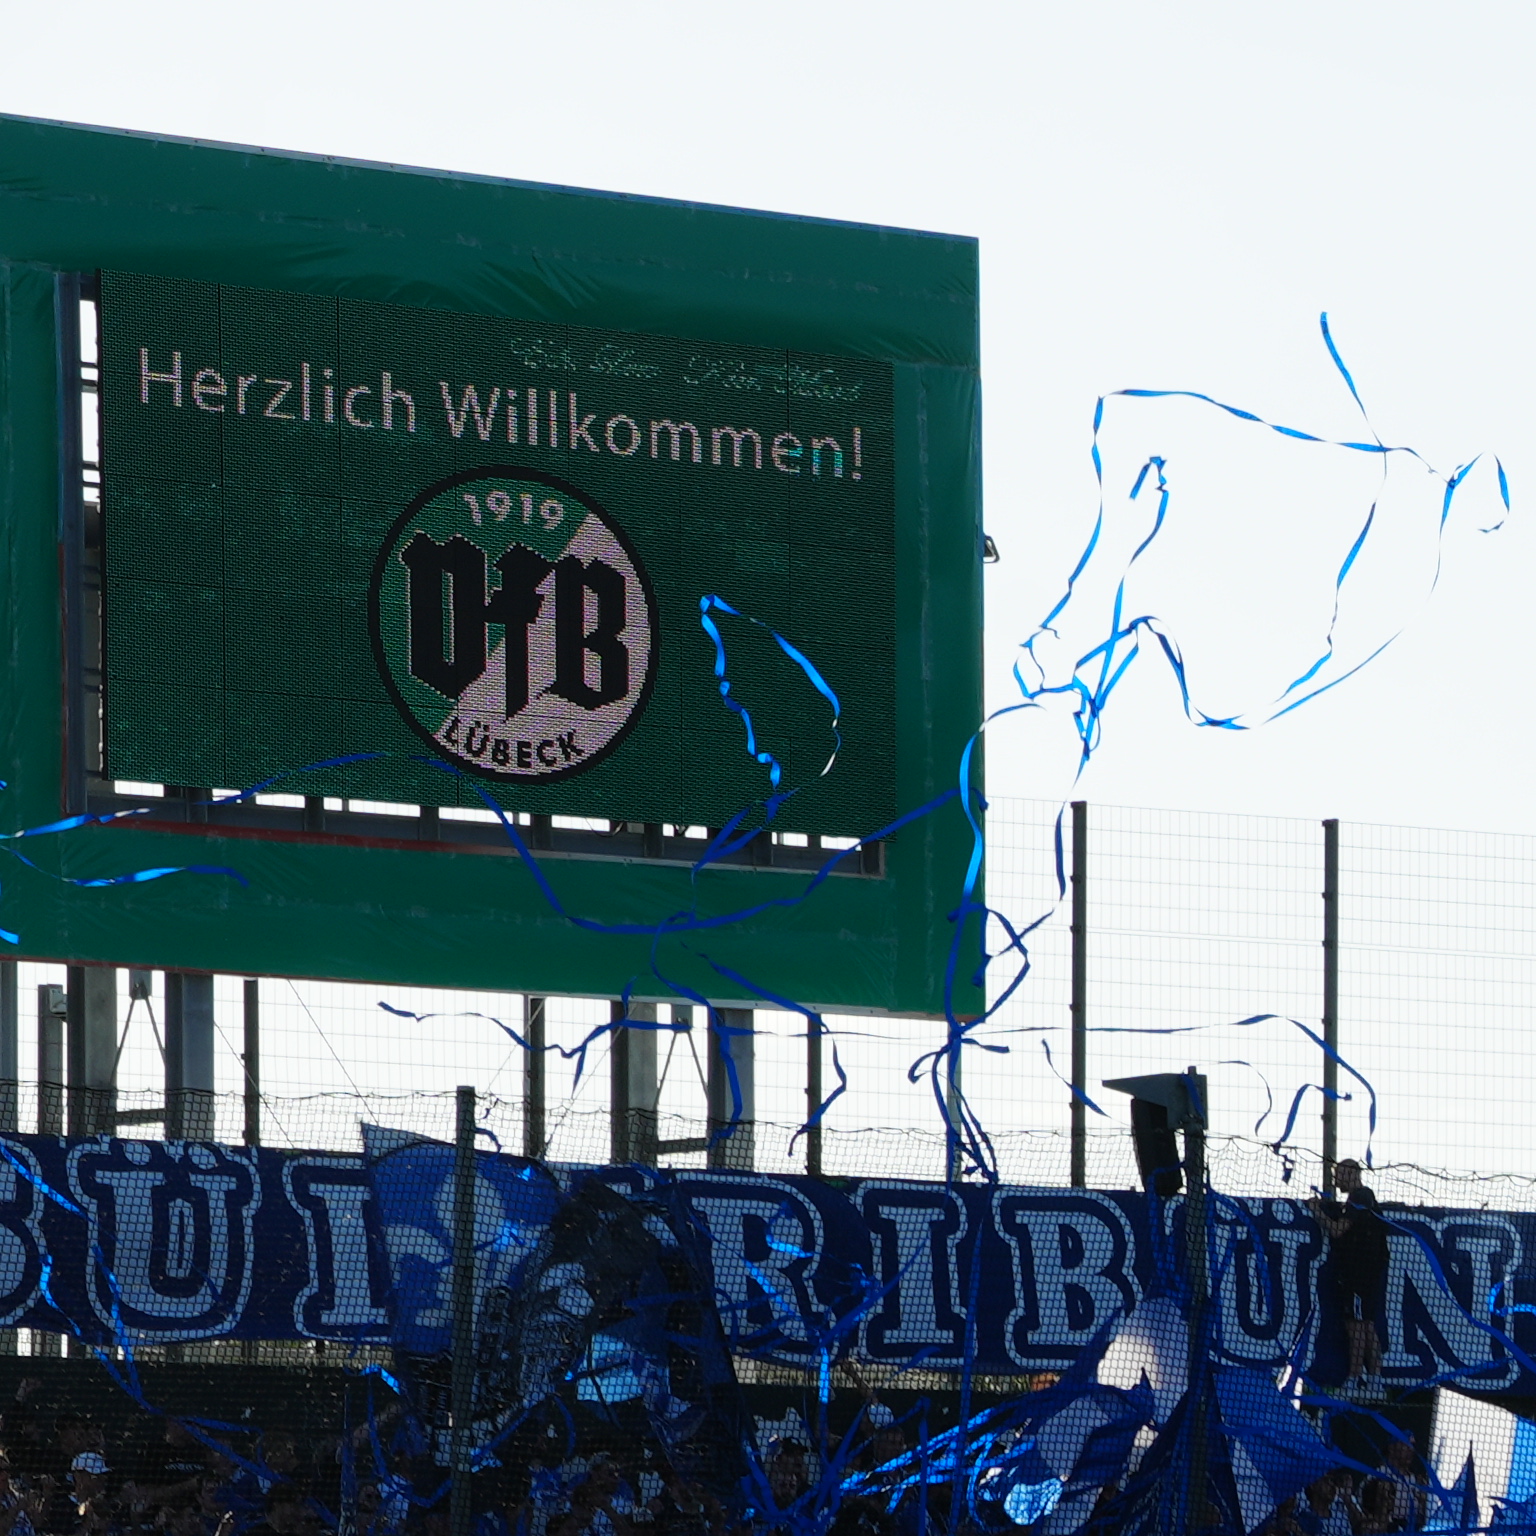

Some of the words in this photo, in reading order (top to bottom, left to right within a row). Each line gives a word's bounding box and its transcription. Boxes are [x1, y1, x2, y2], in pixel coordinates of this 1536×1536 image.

[137, 347, 418, 436] Herzlich
[438, 379, 865, 482] Willkommen!
[462, 490, 566, 532] 1919
[443, 718, 581, 769] LÜBECK
